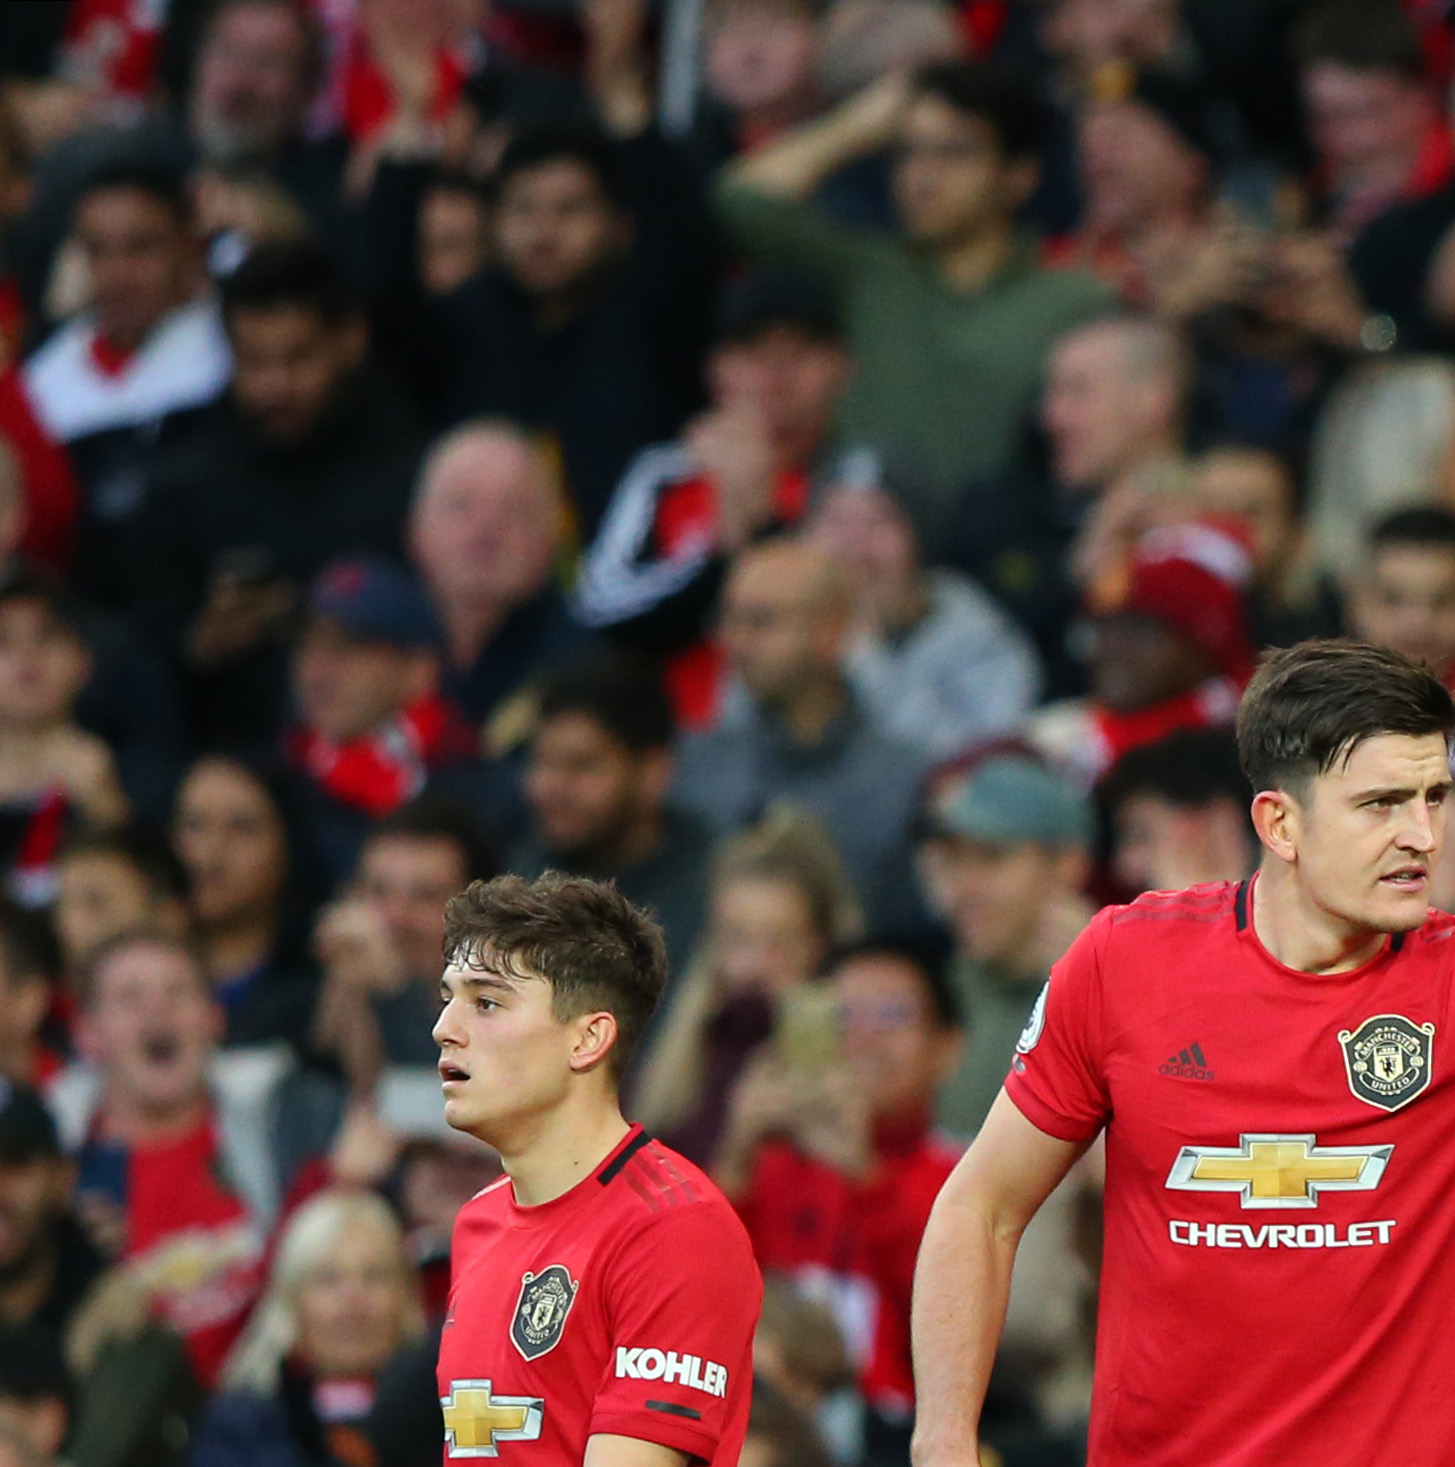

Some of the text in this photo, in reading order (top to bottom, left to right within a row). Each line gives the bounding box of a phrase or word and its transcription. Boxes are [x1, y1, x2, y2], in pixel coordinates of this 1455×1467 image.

[1360, 1033, 1415, 1056] MANCHESTER
[1159, 1064, 1214, 1081] adidas
[1371, 1077, 1410, 1091] UNITED
[1169, 1220, 1397, 1248] CHEVROLET
[616, 1347, 728, 1398] KOHLER
